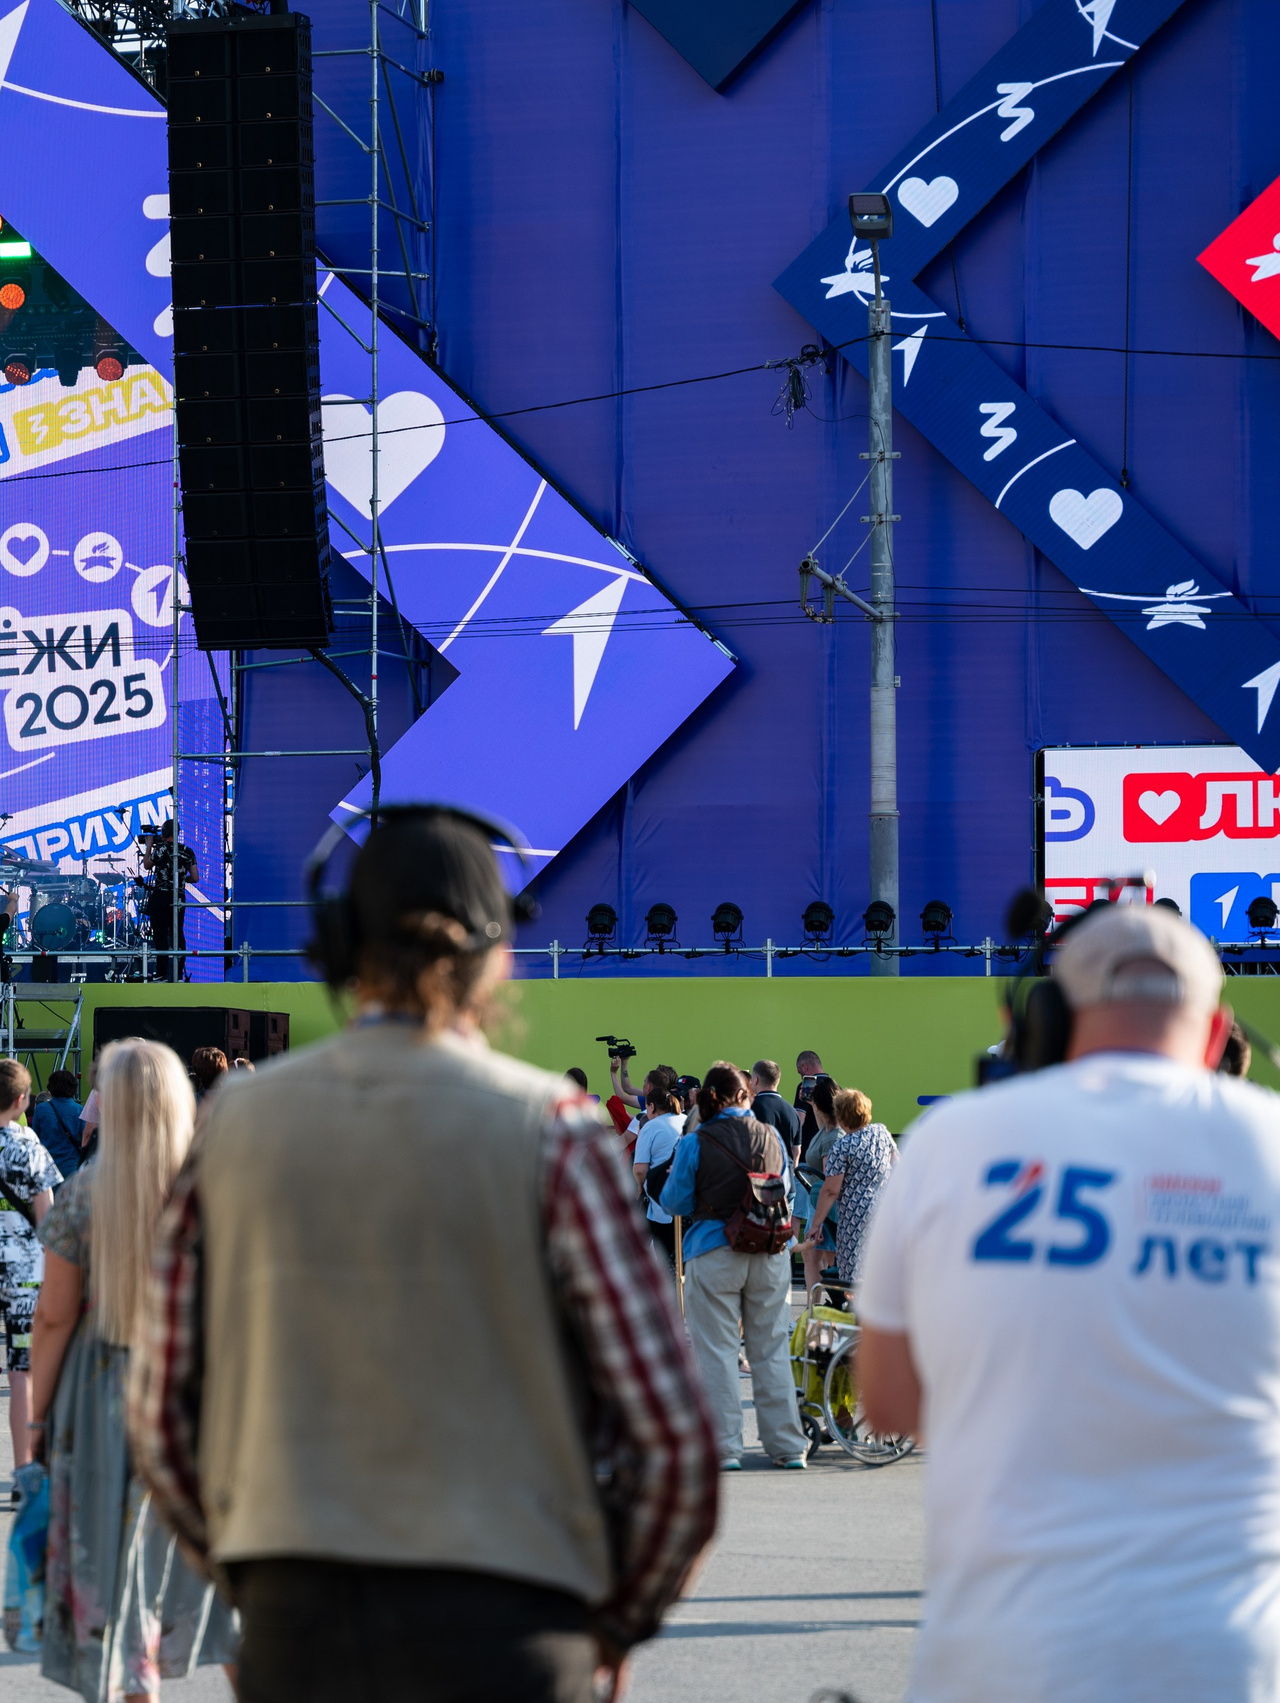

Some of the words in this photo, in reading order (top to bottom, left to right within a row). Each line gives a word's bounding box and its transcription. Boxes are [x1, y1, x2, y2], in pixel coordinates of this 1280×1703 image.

[58, 377, 166, 433] ЗНА
[15, 672, 154, 739] 2025
[973, 1159, 1116, 1269] 25
[1132, 1235, 1268, 1287] лет
